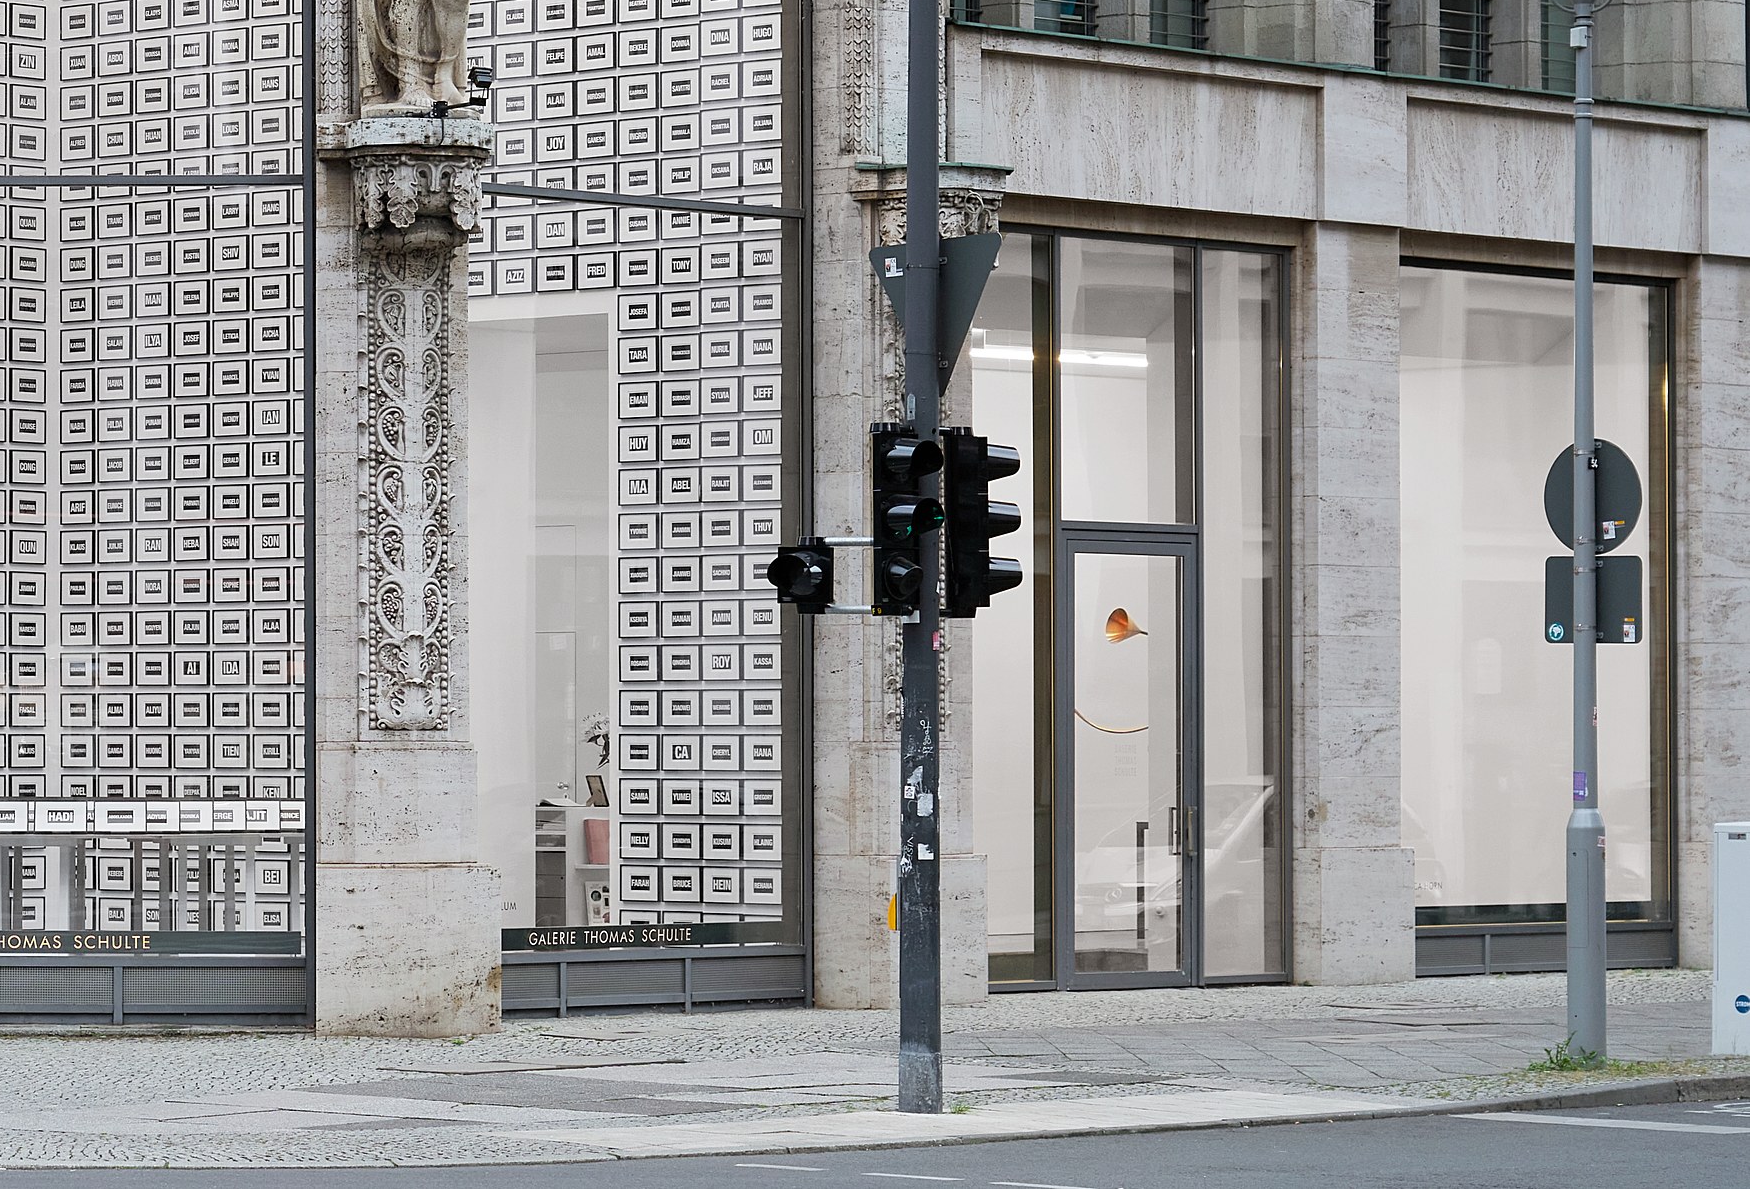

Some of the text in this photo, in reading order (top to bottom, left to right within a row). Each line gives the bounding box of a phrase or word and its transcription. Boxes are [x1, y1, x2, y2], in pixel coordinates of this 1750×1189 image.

[587, 46, 604, 58] AMAL
[20, 54, 35, 69] ZIN
[547, 95, 564, 106] ALAN
[547, 136, 564, 151] JOY
[223, 247, 239, 259] SHIV
[753, 251, 772, 264] RYAN
[587, 265, 605, 276] FRED
[673, 260, 690, 271] TONY
[506, 270, 524, 282] AZIZ
[145, 334, 161, 347] ILYA
[753, 341, 772, 352] NANA
[630, 349, 647, 360] TARA
[754, 387, 773, 399] JEFF
[263, 410, 279, 424] IAN
[754, 429, 771, 444] OM
[629, 437, 647, 450] HUY
[265, 452, 277, 465] LE
[630, 480, 647, 494] MA
[672, 480, 689, 490] ABEL
[70, 502, 85, 513] ARIF
[754, 522, 772, 532] THUY
[19, 541, 36, 553] QUN
[145, 539, 161, 551] RAN
[262, 535, 279, 547] SON
[754, 612, 772, 622] RENU
[70, 624, 86, 633] BABU
[187, 662, 197, 674] AI
[223, 661, 238, 674] IDA
[712, 656, 730, 668] ROY
[224, 745, 239, 756] TIEN
[674, 746, 689, 759] CA
[754, 748, 772, 757] HANA
[631, 792, 649, 800] SAMIA
[713, 791, 730, 803] ISSA
[48, 811, 74, 822] HADI
[631, 836, 649, 845] NELLY
[264, 870, 280, 883] BEI
[73, 935, 151, 950] SCHULTE
[528, 927, 692, 946] GALERIE THOMAS SCHULTE
